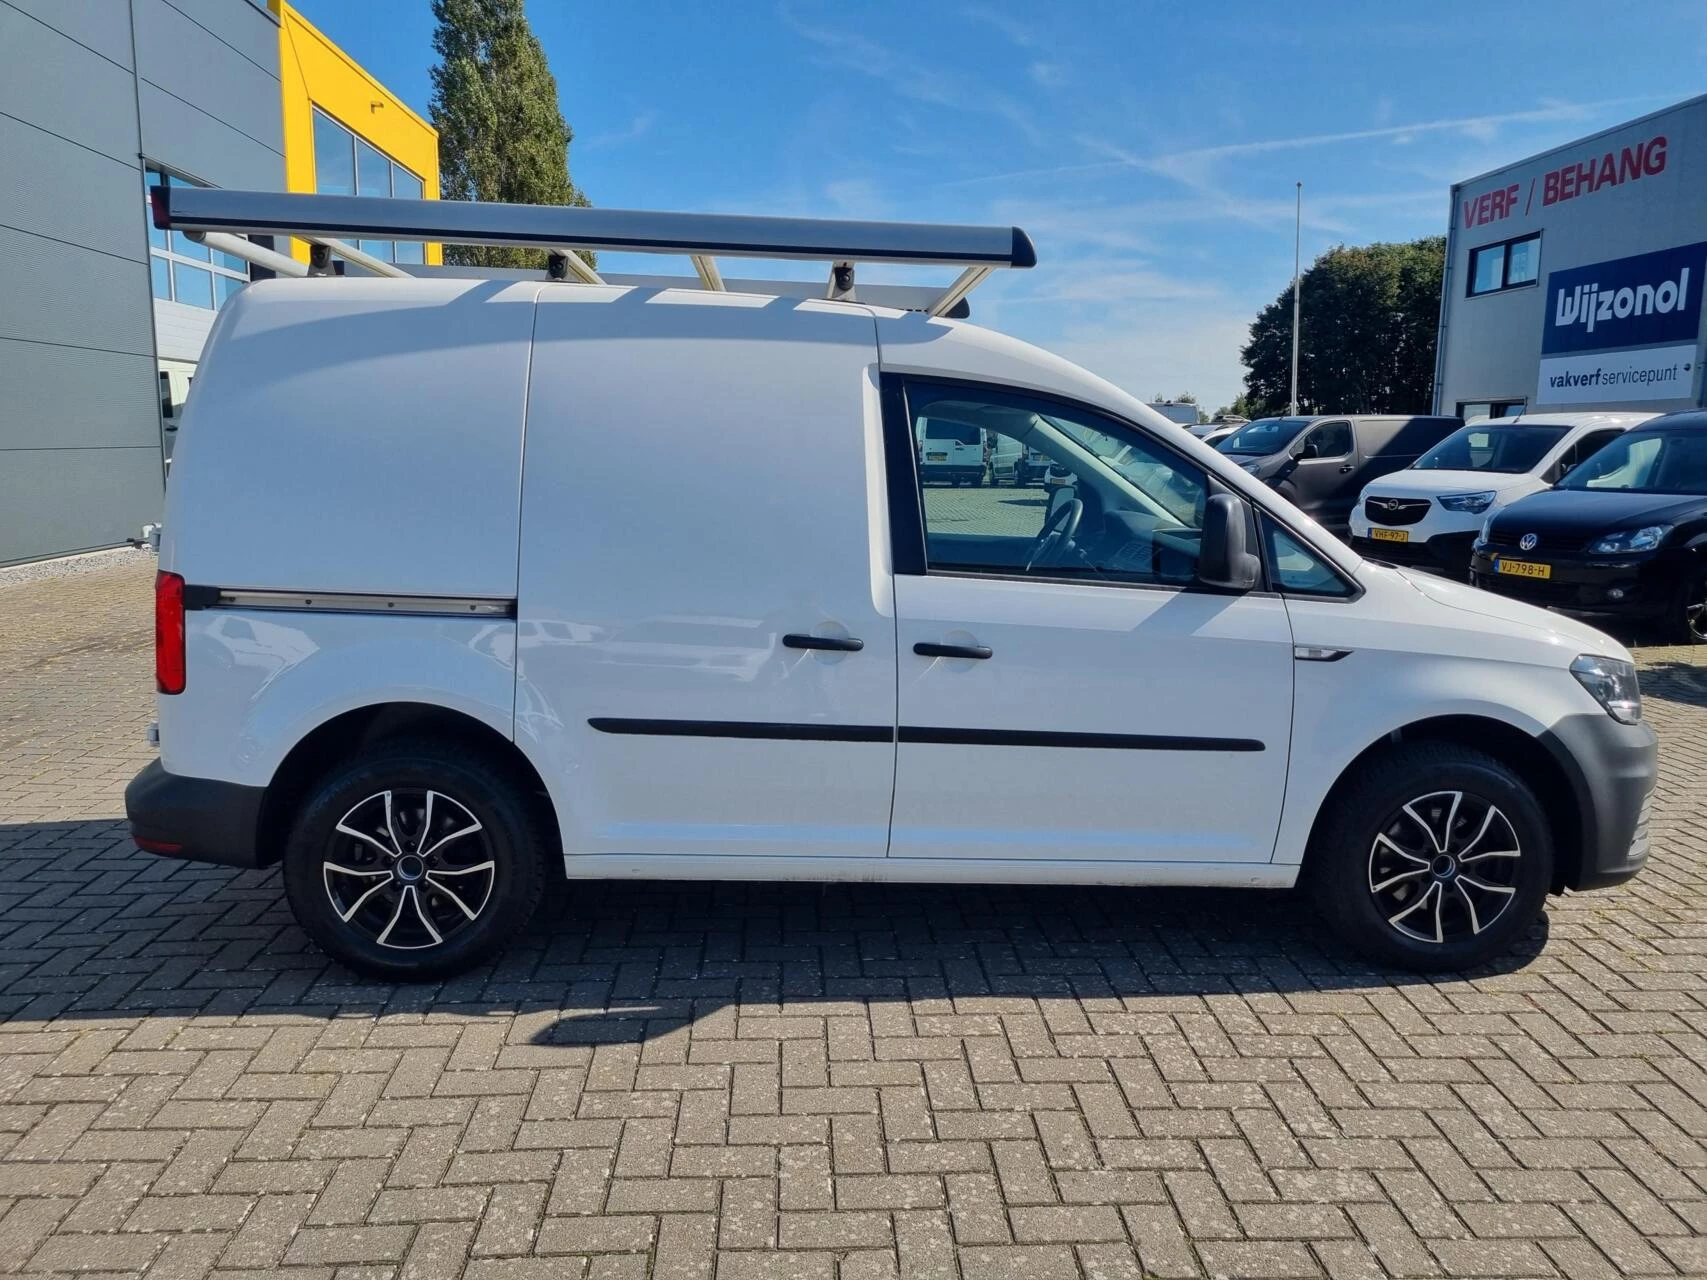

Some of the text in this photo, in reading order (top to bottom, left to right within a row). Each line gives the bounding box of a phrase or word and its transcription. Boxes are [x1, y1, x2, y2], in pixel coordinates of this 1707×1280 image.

[1464, 184, 1520, 229] VERF
[1542, 136, 1668, 207] BEHANG
[1555, 267, 1690, 333] Wijzonol
[1501, 561, 1545, 576] VJ-798-H
